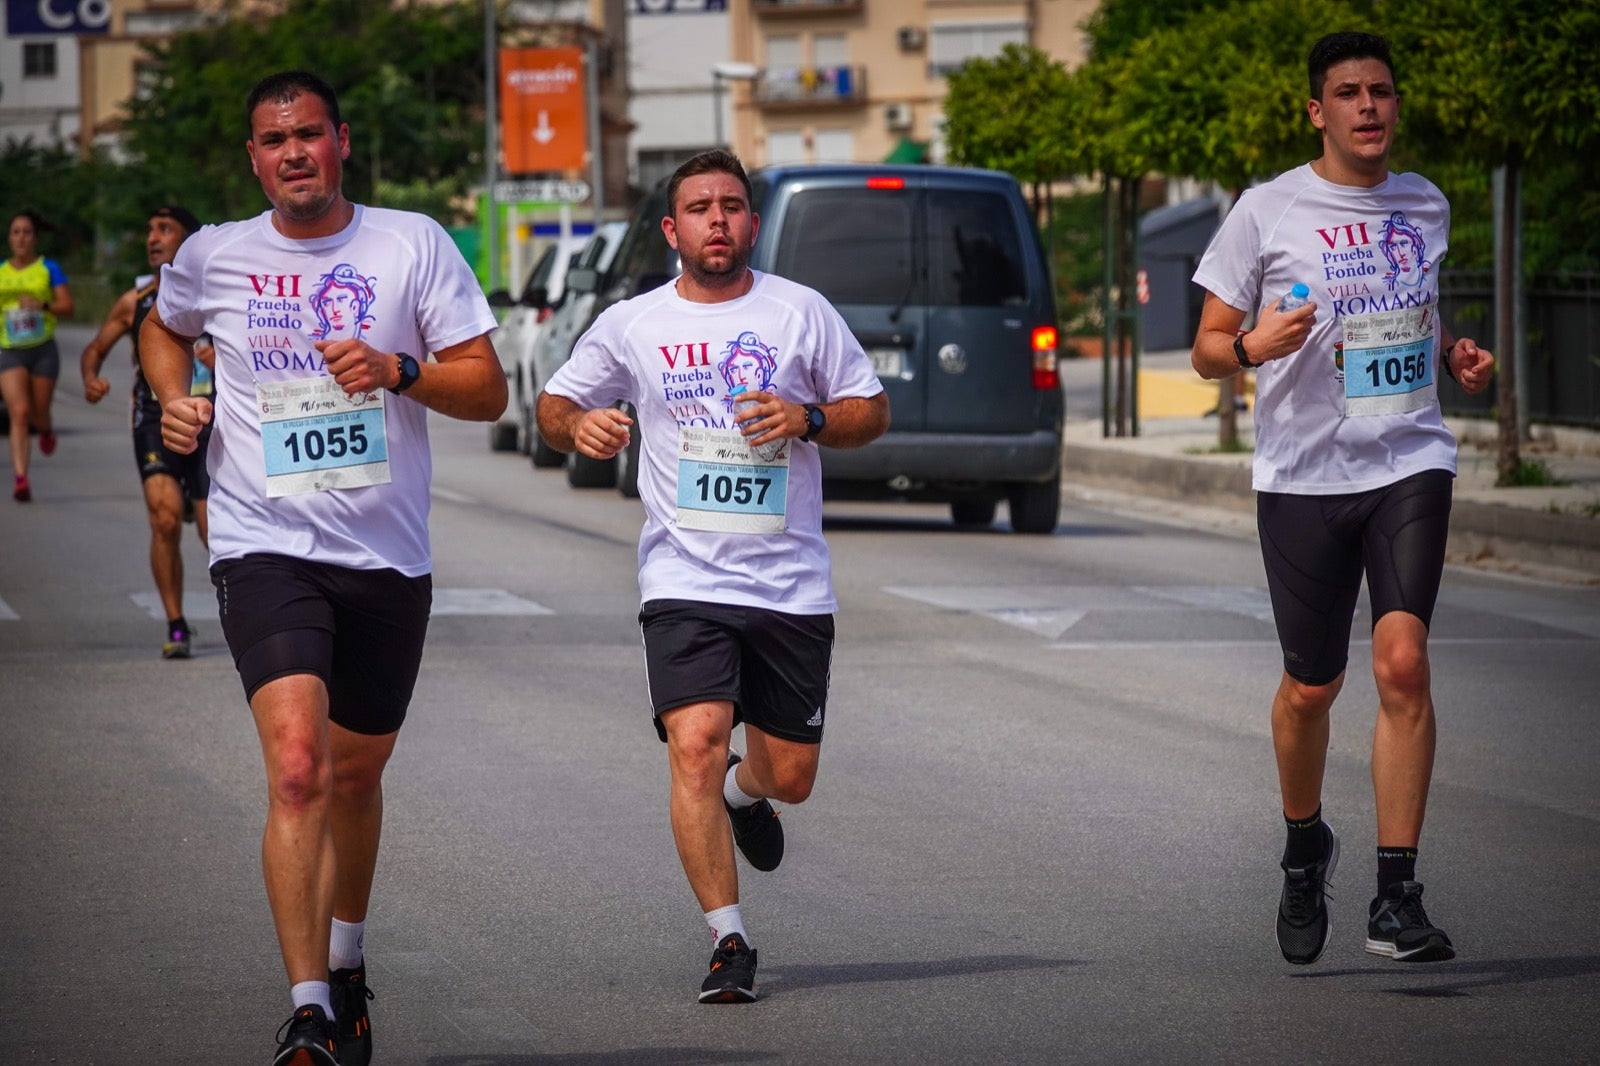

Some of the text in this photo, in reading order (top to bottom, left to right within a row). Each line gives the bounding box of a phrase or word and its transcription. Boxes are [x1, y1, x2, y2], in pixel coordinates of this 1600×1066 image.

[1315, 222, 1371, 249] VII
[1322, 247, 1373, 264] Prueba
[1324, 262, 1376, 281] Fondo
[246, 274, 302, 297] VII
[1327, 283, 1370, 298] VILLA
[247, 299, 301, 312] Prueba
[247, 314, 302, 329] Fondo
[248, 335, 292, 349] VILLA
[658, 342, 711, 369] VII
[662, 368, 712, 385] Prueba
[1366, 352, 1426, 387] 1056
[664, 383, 715, 401] Fondo
[668, 404, 710, 419] VILLA
[284, 424, 368, 463] 1055
[696, 474, 772, 505] 1057
